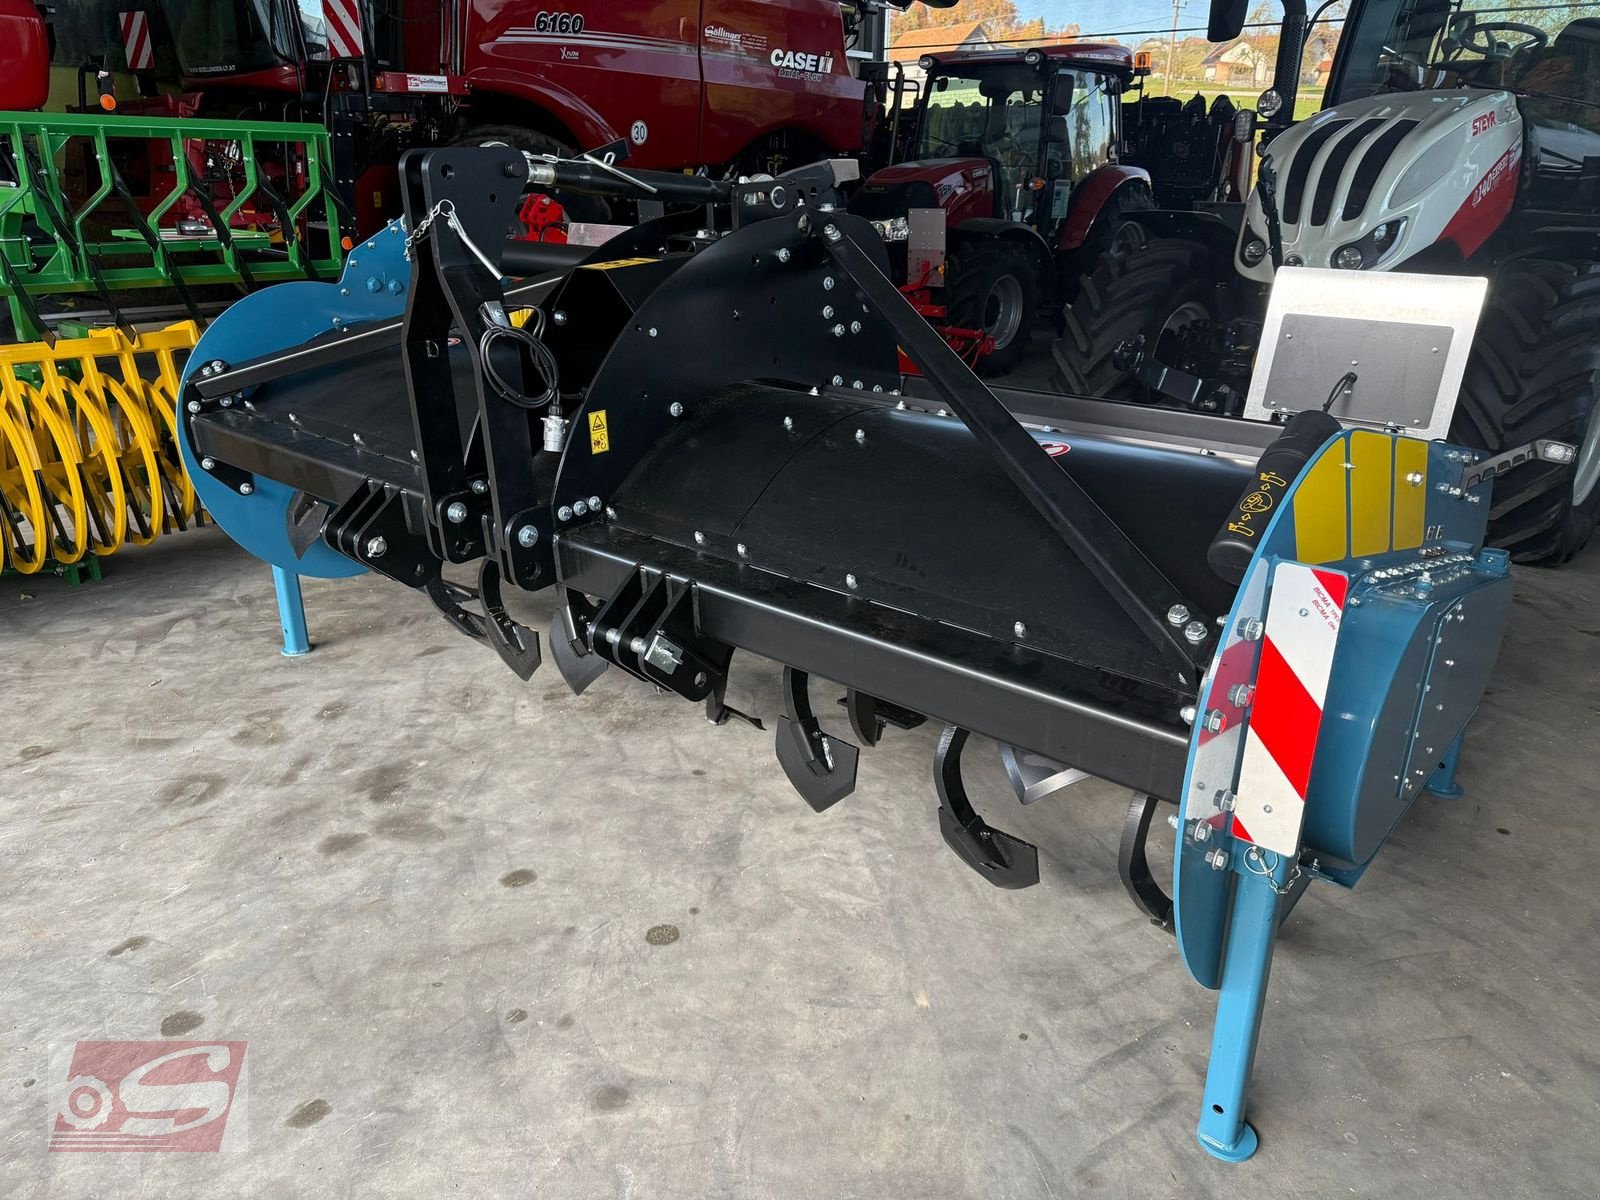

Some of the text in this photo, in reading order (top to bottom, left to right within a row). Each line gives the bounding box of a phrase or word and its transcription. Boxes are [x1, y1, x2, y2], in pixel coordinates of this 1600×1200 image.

[535, 11, 584, 35] 6160
[770, 49, 818, 72] CASE
[633, 125, 646, 141] 30
[1472, 110, 1496, 137] STEYR
[1313, 587, 1331, 608] BICMA
[1312, 599, 1330, 620] BICMA
